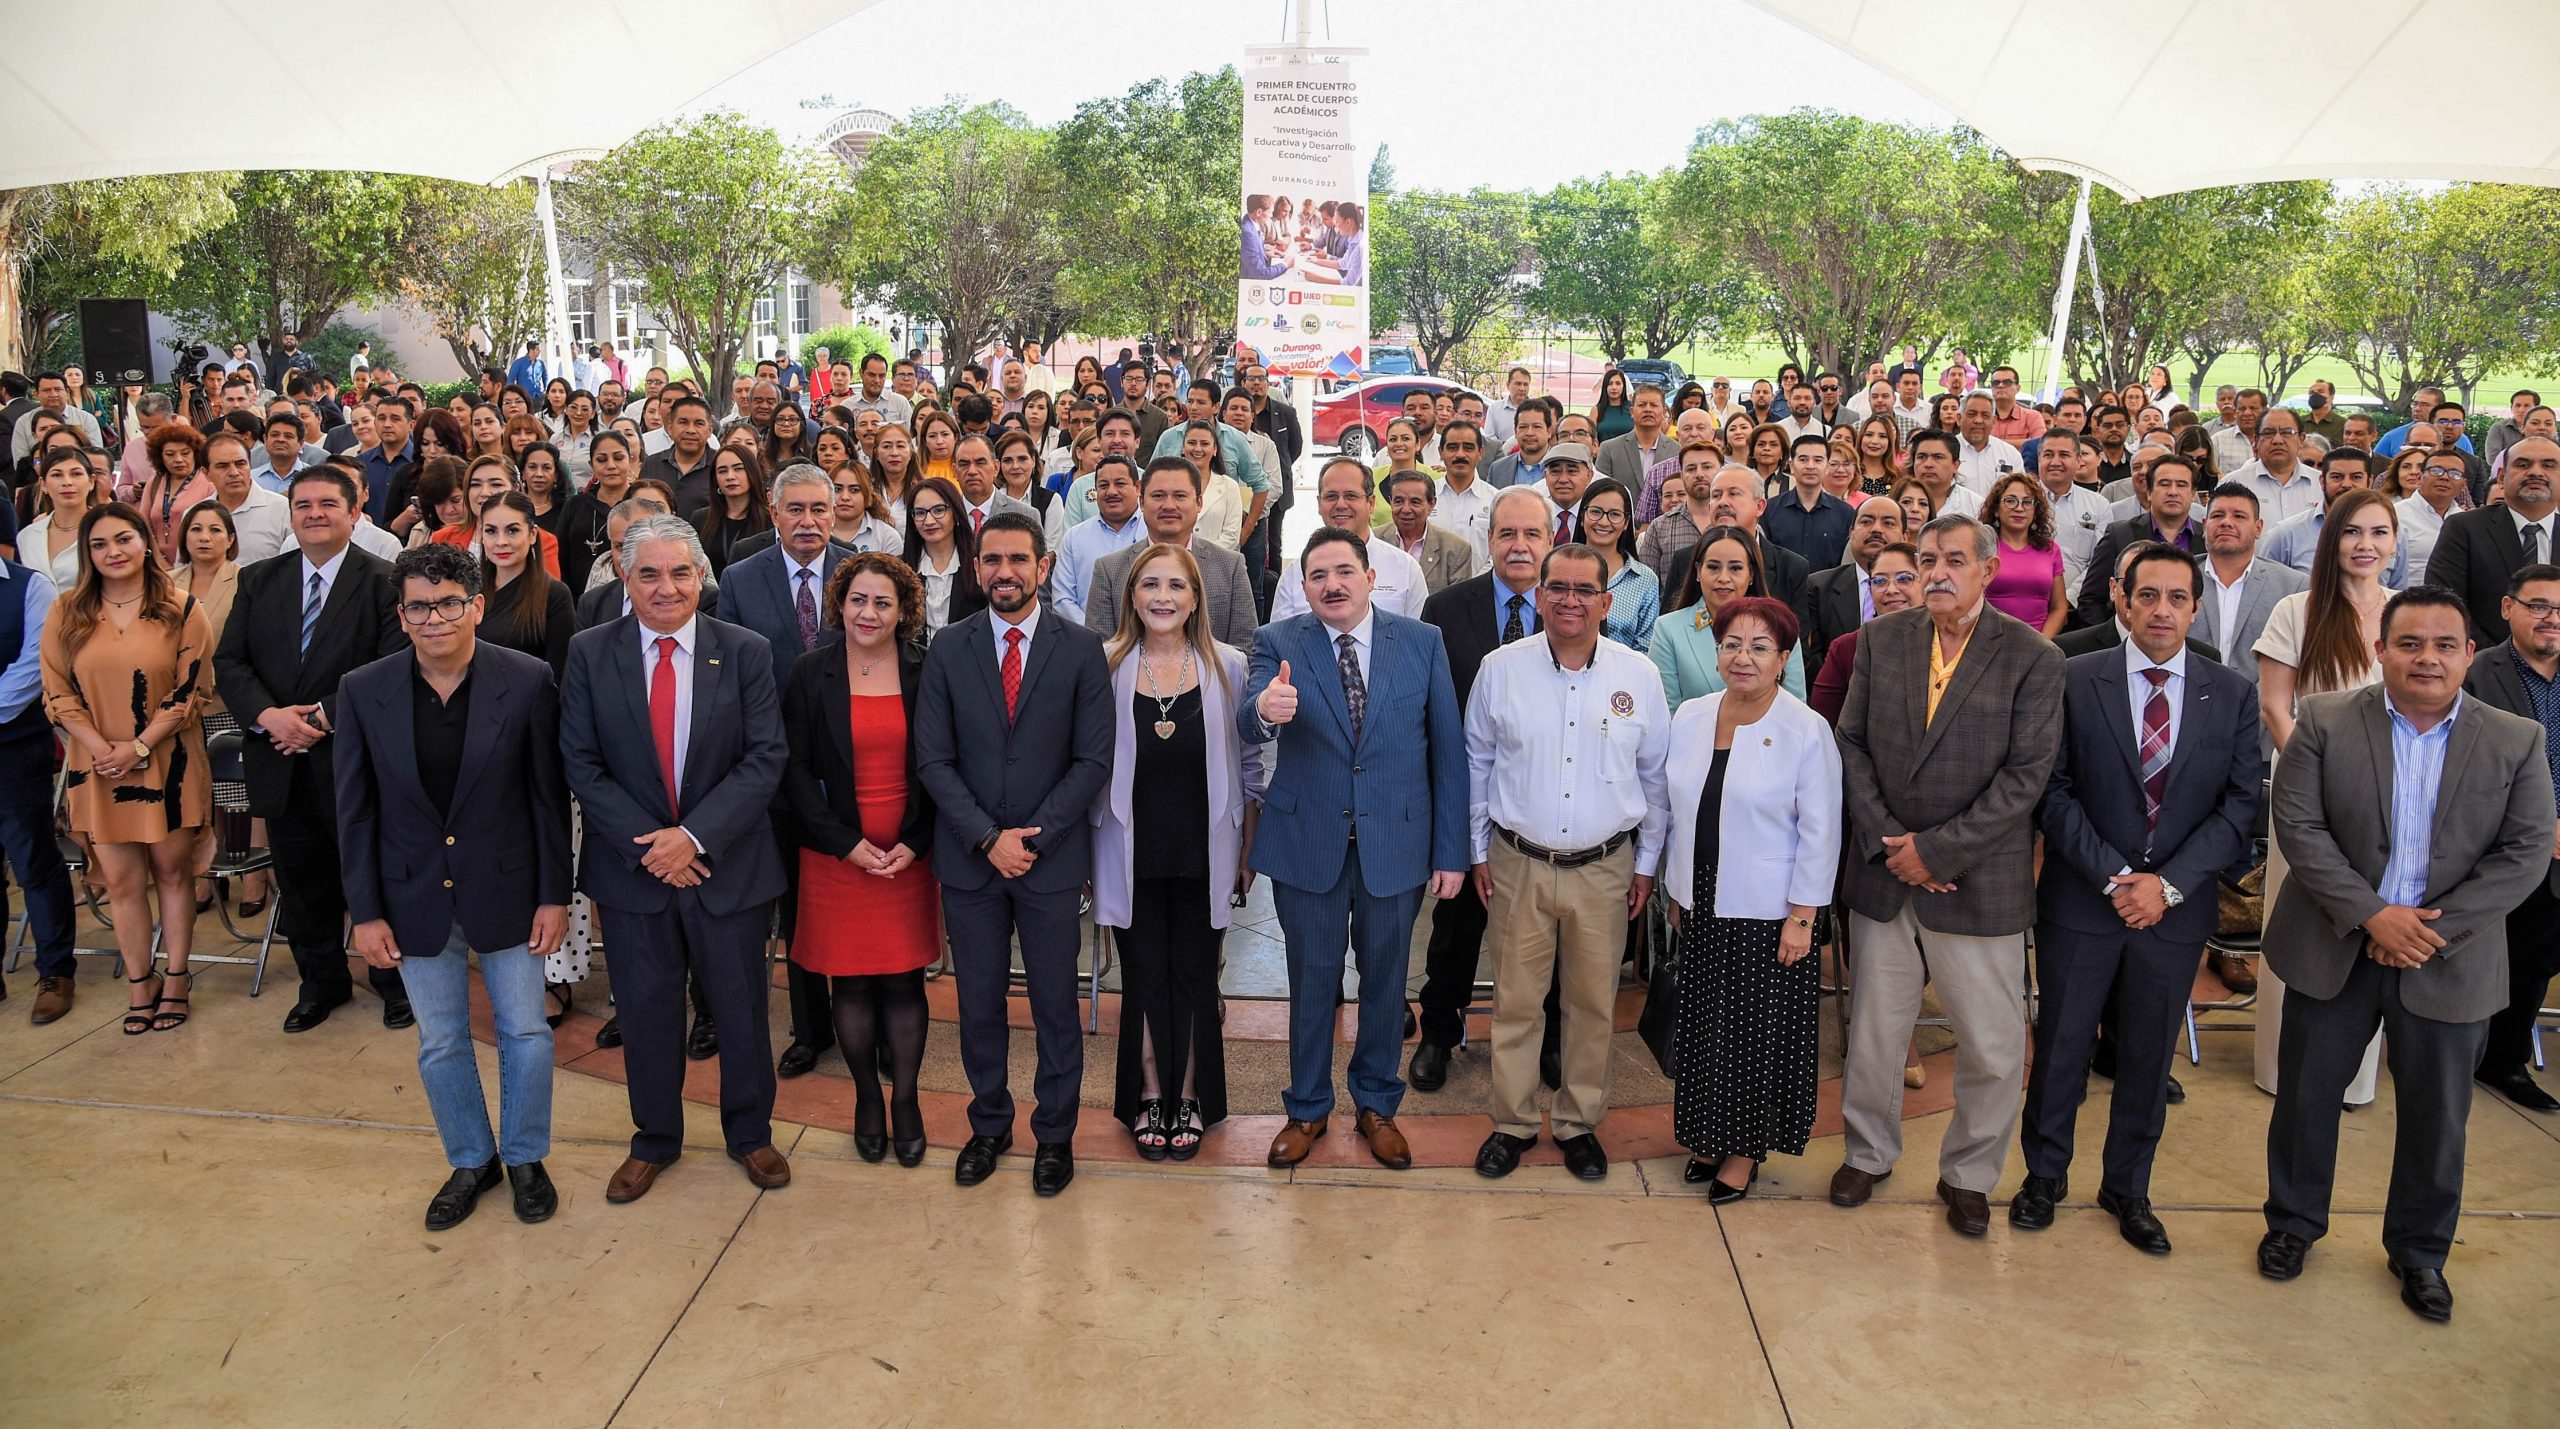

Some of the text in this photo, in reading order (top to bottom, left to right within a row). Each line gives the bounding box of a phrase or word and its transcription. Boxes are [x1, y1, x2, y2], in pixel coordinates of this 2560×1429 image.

[1256, 81, 1357, 91] PRIMER ENCUENTRO
[1254, 93, 1358, 104] ESTATAL DE CUERPOS
[1273, 105, 1338, 118] ACADÉMICOS
[1254, 138, 1356, 152] Educativa y Desarrollo
[1272, 175, 1337, 188] DURANGO 2023
[1303, 292, 1321, 300] UJED
